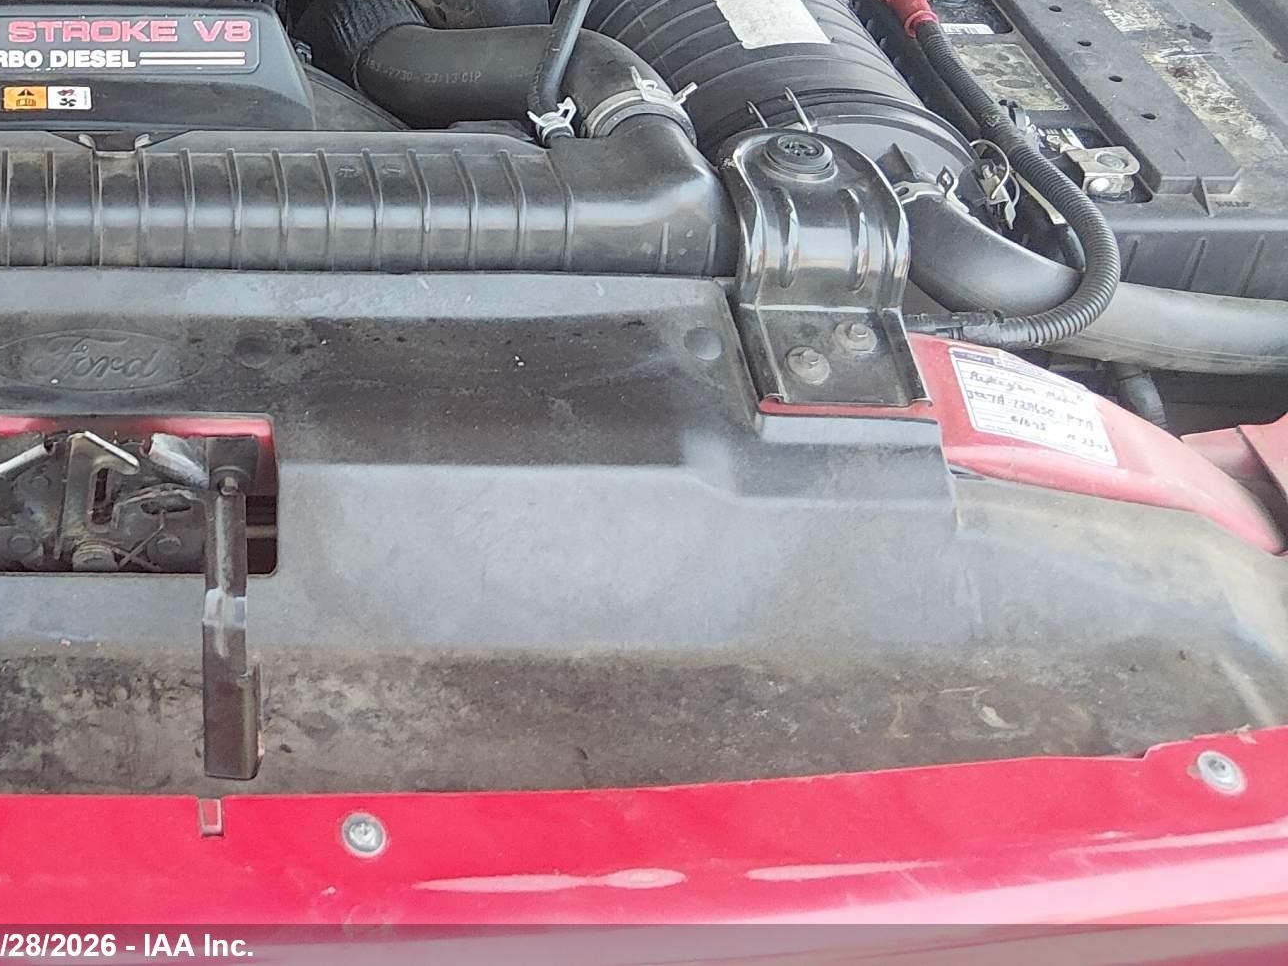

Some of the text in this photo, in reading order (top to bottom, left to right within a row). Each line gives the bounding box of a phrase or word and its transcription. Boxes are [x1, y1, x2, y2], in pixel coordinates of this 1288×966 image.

[8, 20, 178, 43] STROKE
[194, 20, 252, 43] V8
[50, 50, 136, 68] DIESEL
[30, 335, 165, 379] Ford
